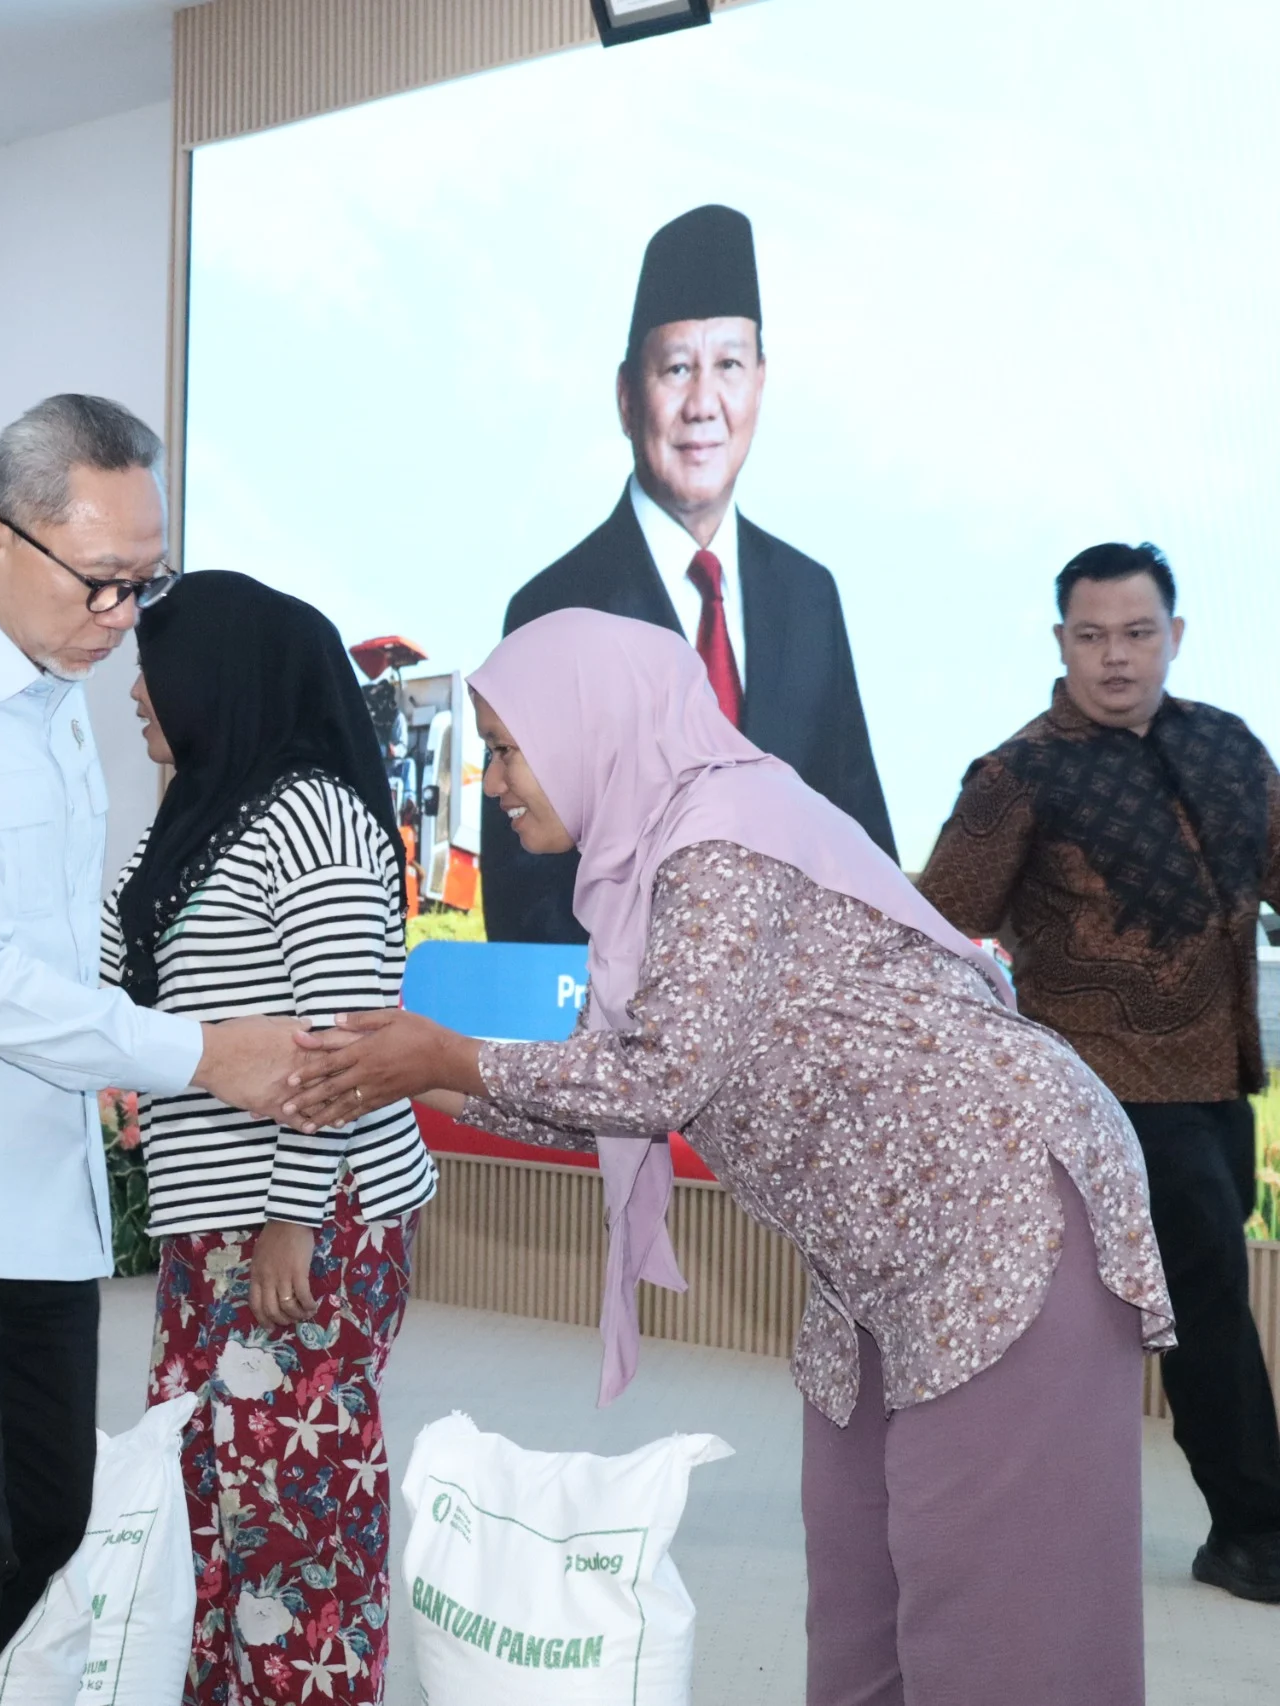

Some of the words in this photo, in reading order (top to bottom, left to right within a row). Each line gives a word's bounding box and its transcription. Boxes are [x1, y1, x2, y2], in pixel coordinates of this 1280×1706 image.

[575, 1552, 623, 1575] bulog
[412, 1575, 496, 1654] BANTUAN
[496, 1625, 604, 1670] PANGAN
